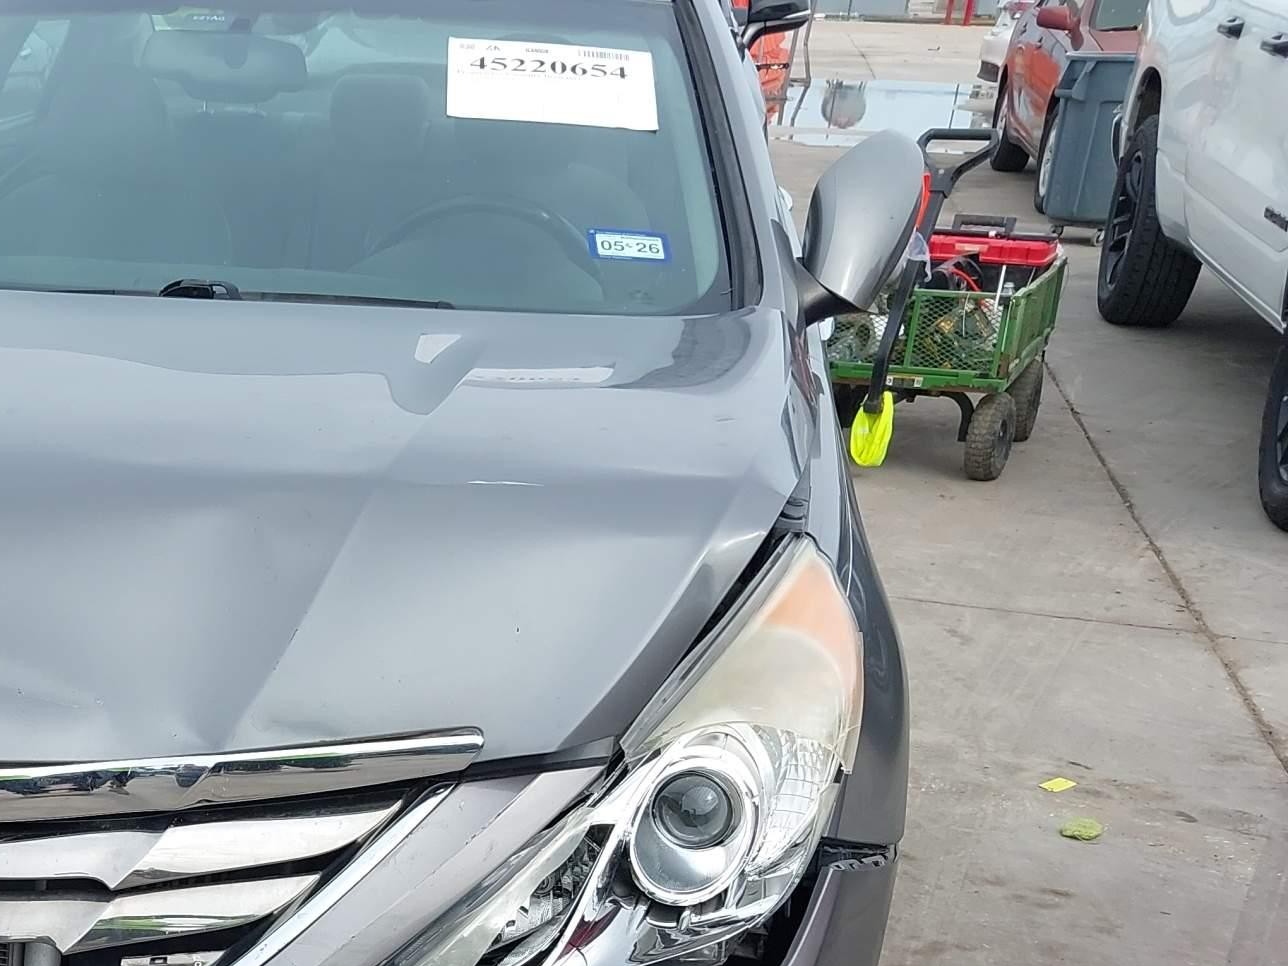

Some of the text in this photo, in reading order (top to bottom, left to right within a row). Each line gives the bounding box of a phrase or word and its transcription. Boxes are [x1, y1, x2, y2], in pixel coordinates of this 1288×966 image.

[470, 56, 628, 79] 45220654
[601, 240, 660, 254] 05 26
